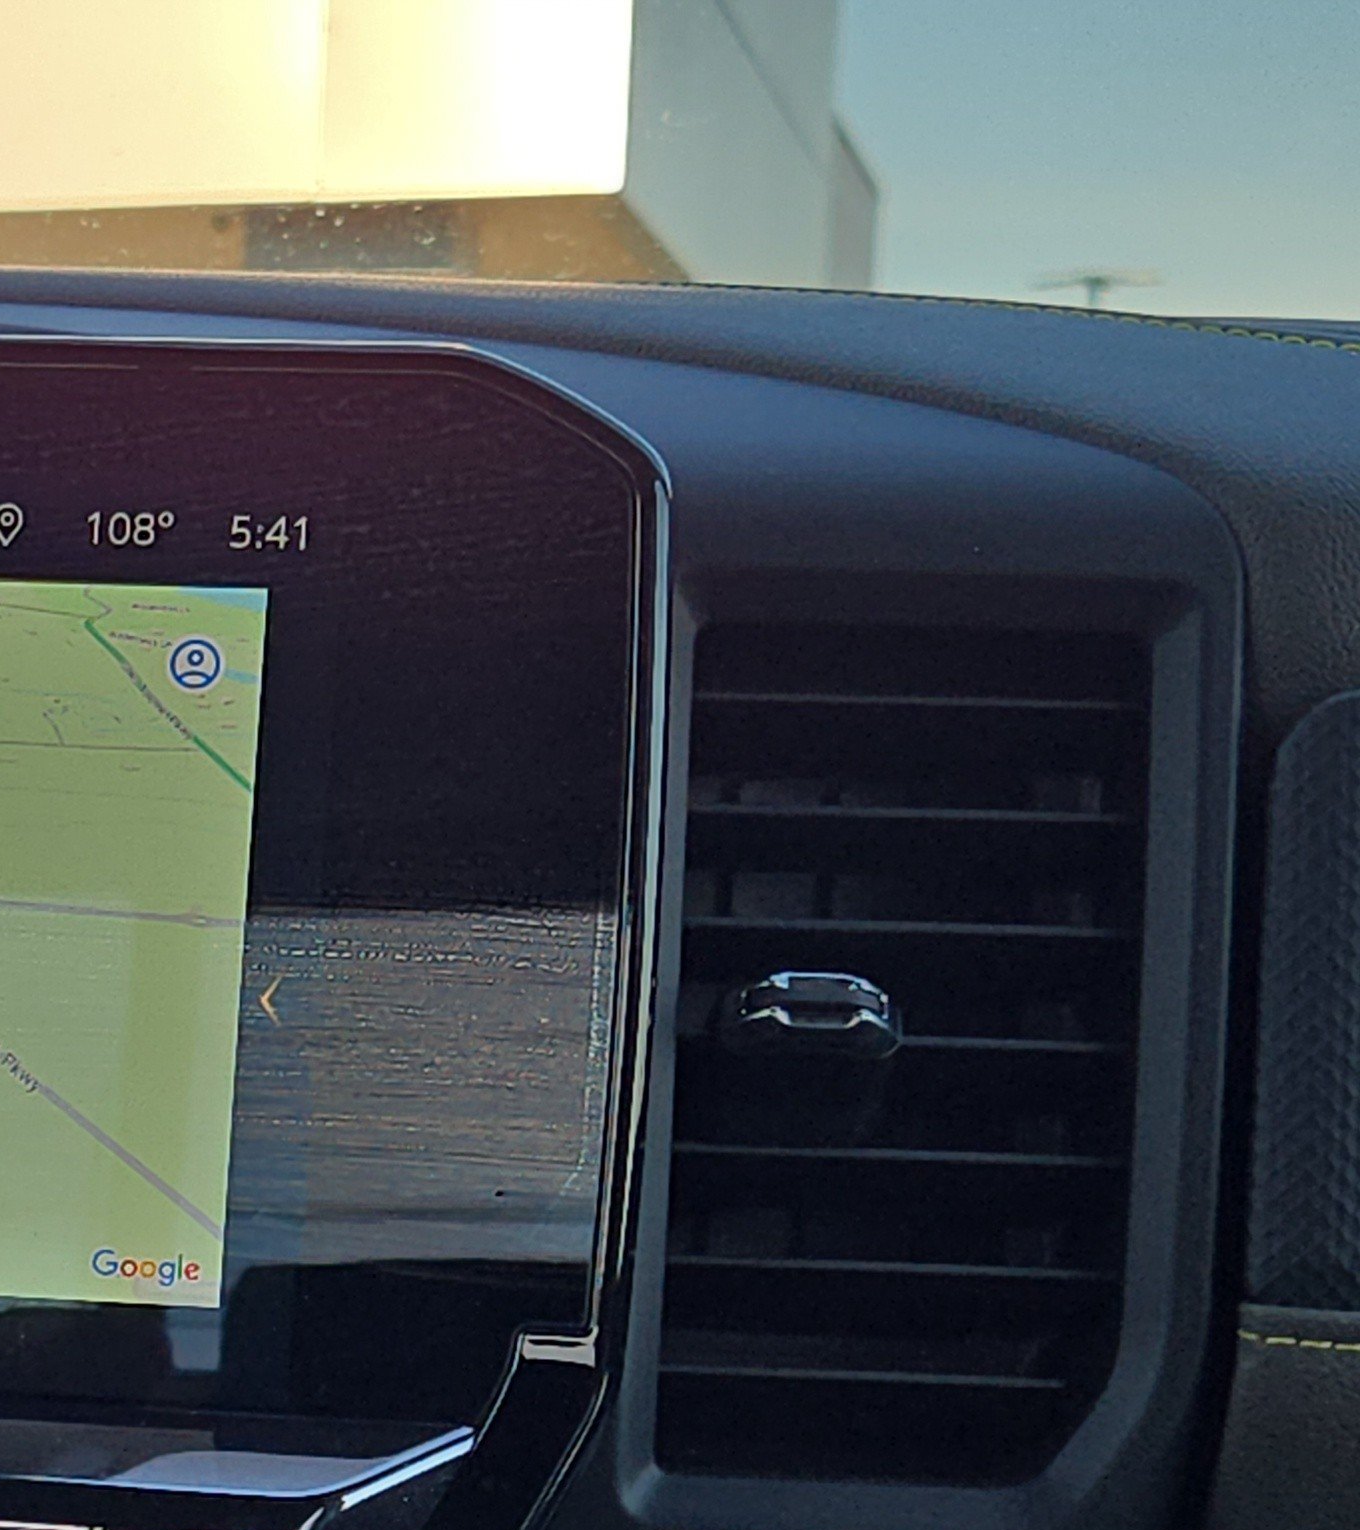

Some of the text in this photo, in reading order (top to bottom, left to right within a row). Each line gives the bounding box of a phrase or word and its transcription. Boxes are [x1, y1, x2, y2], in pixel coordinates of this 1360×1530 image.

[87, 511, 175, 546] 108°
[229, 515, 308, 550] 5:41
[0, 1052, 40, 1094] Pkwy
[92, 1249, 200, 1287] Google
